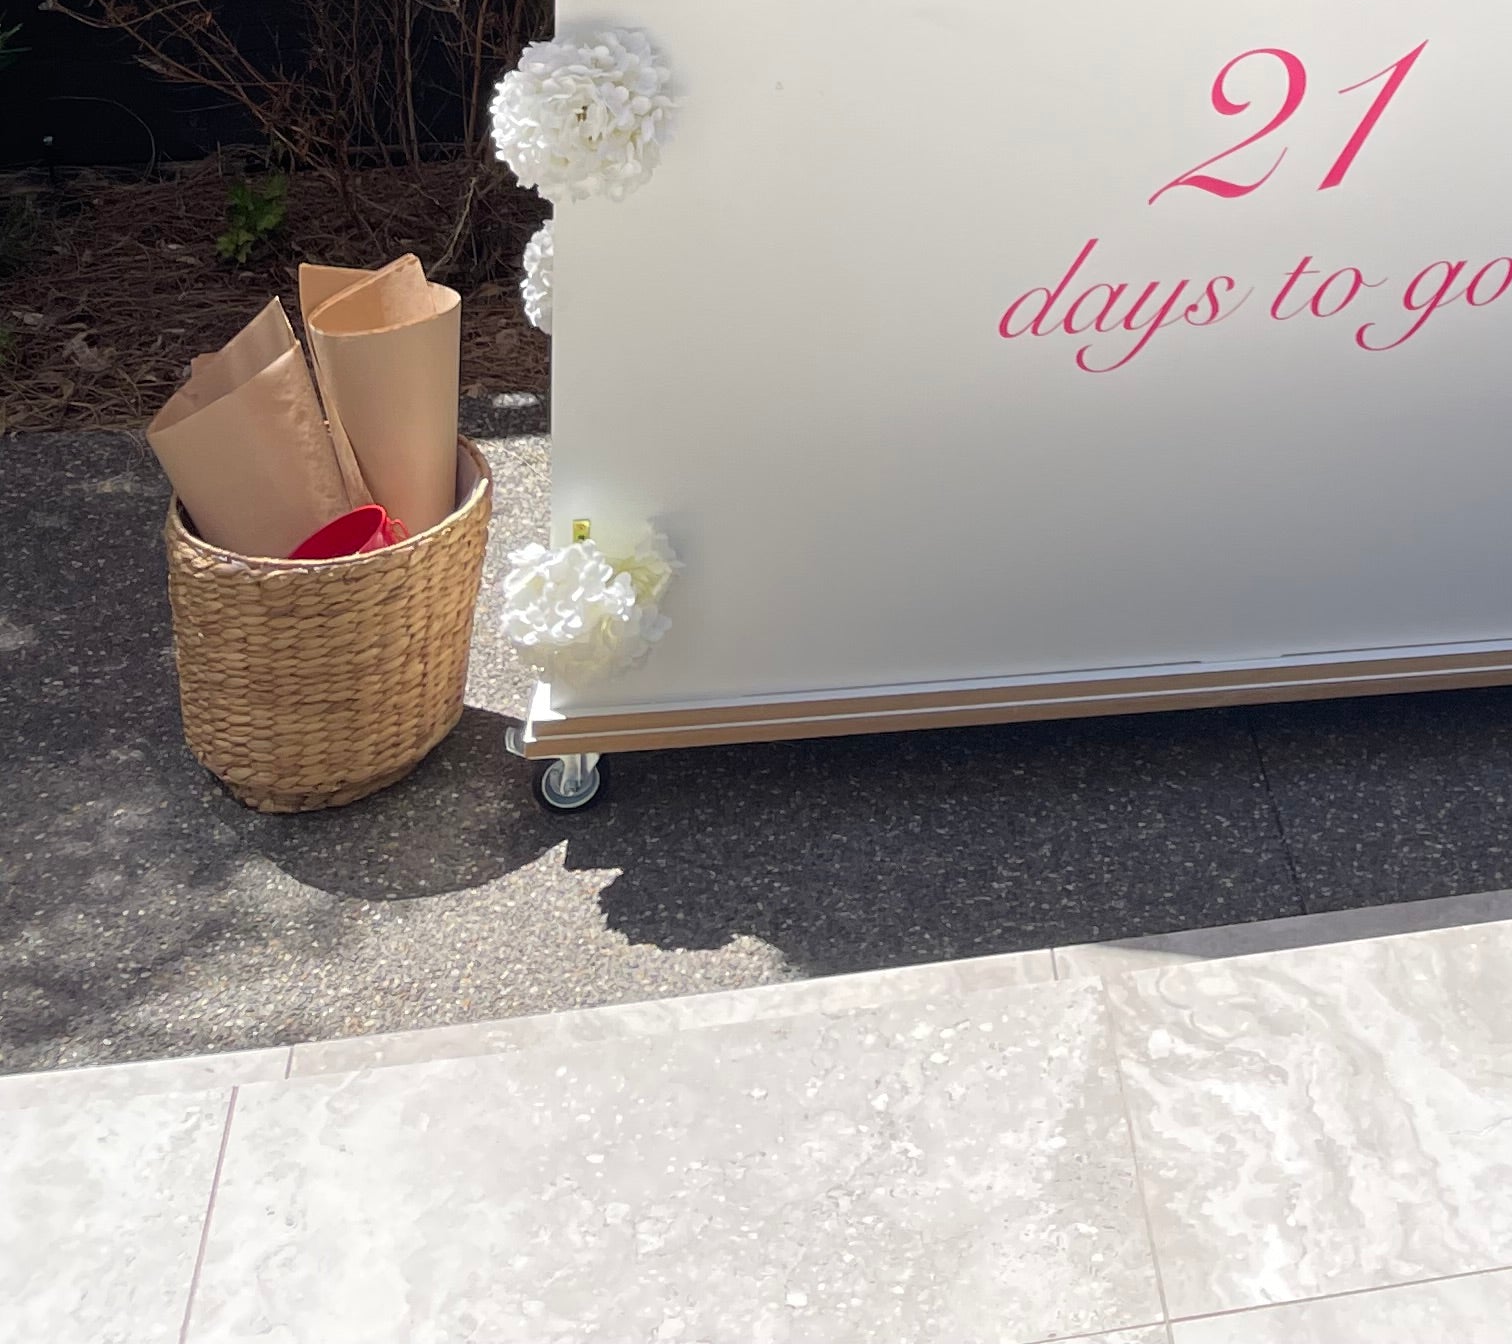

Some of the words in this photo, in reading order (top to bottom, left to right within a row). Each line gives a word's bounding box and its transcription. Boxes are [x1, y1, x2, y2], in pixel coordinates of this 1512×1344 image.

[1148, 39, 1430, 205] 21
[997, 238, 1254, 373] days
[1269, 255, 1388, 321] to
